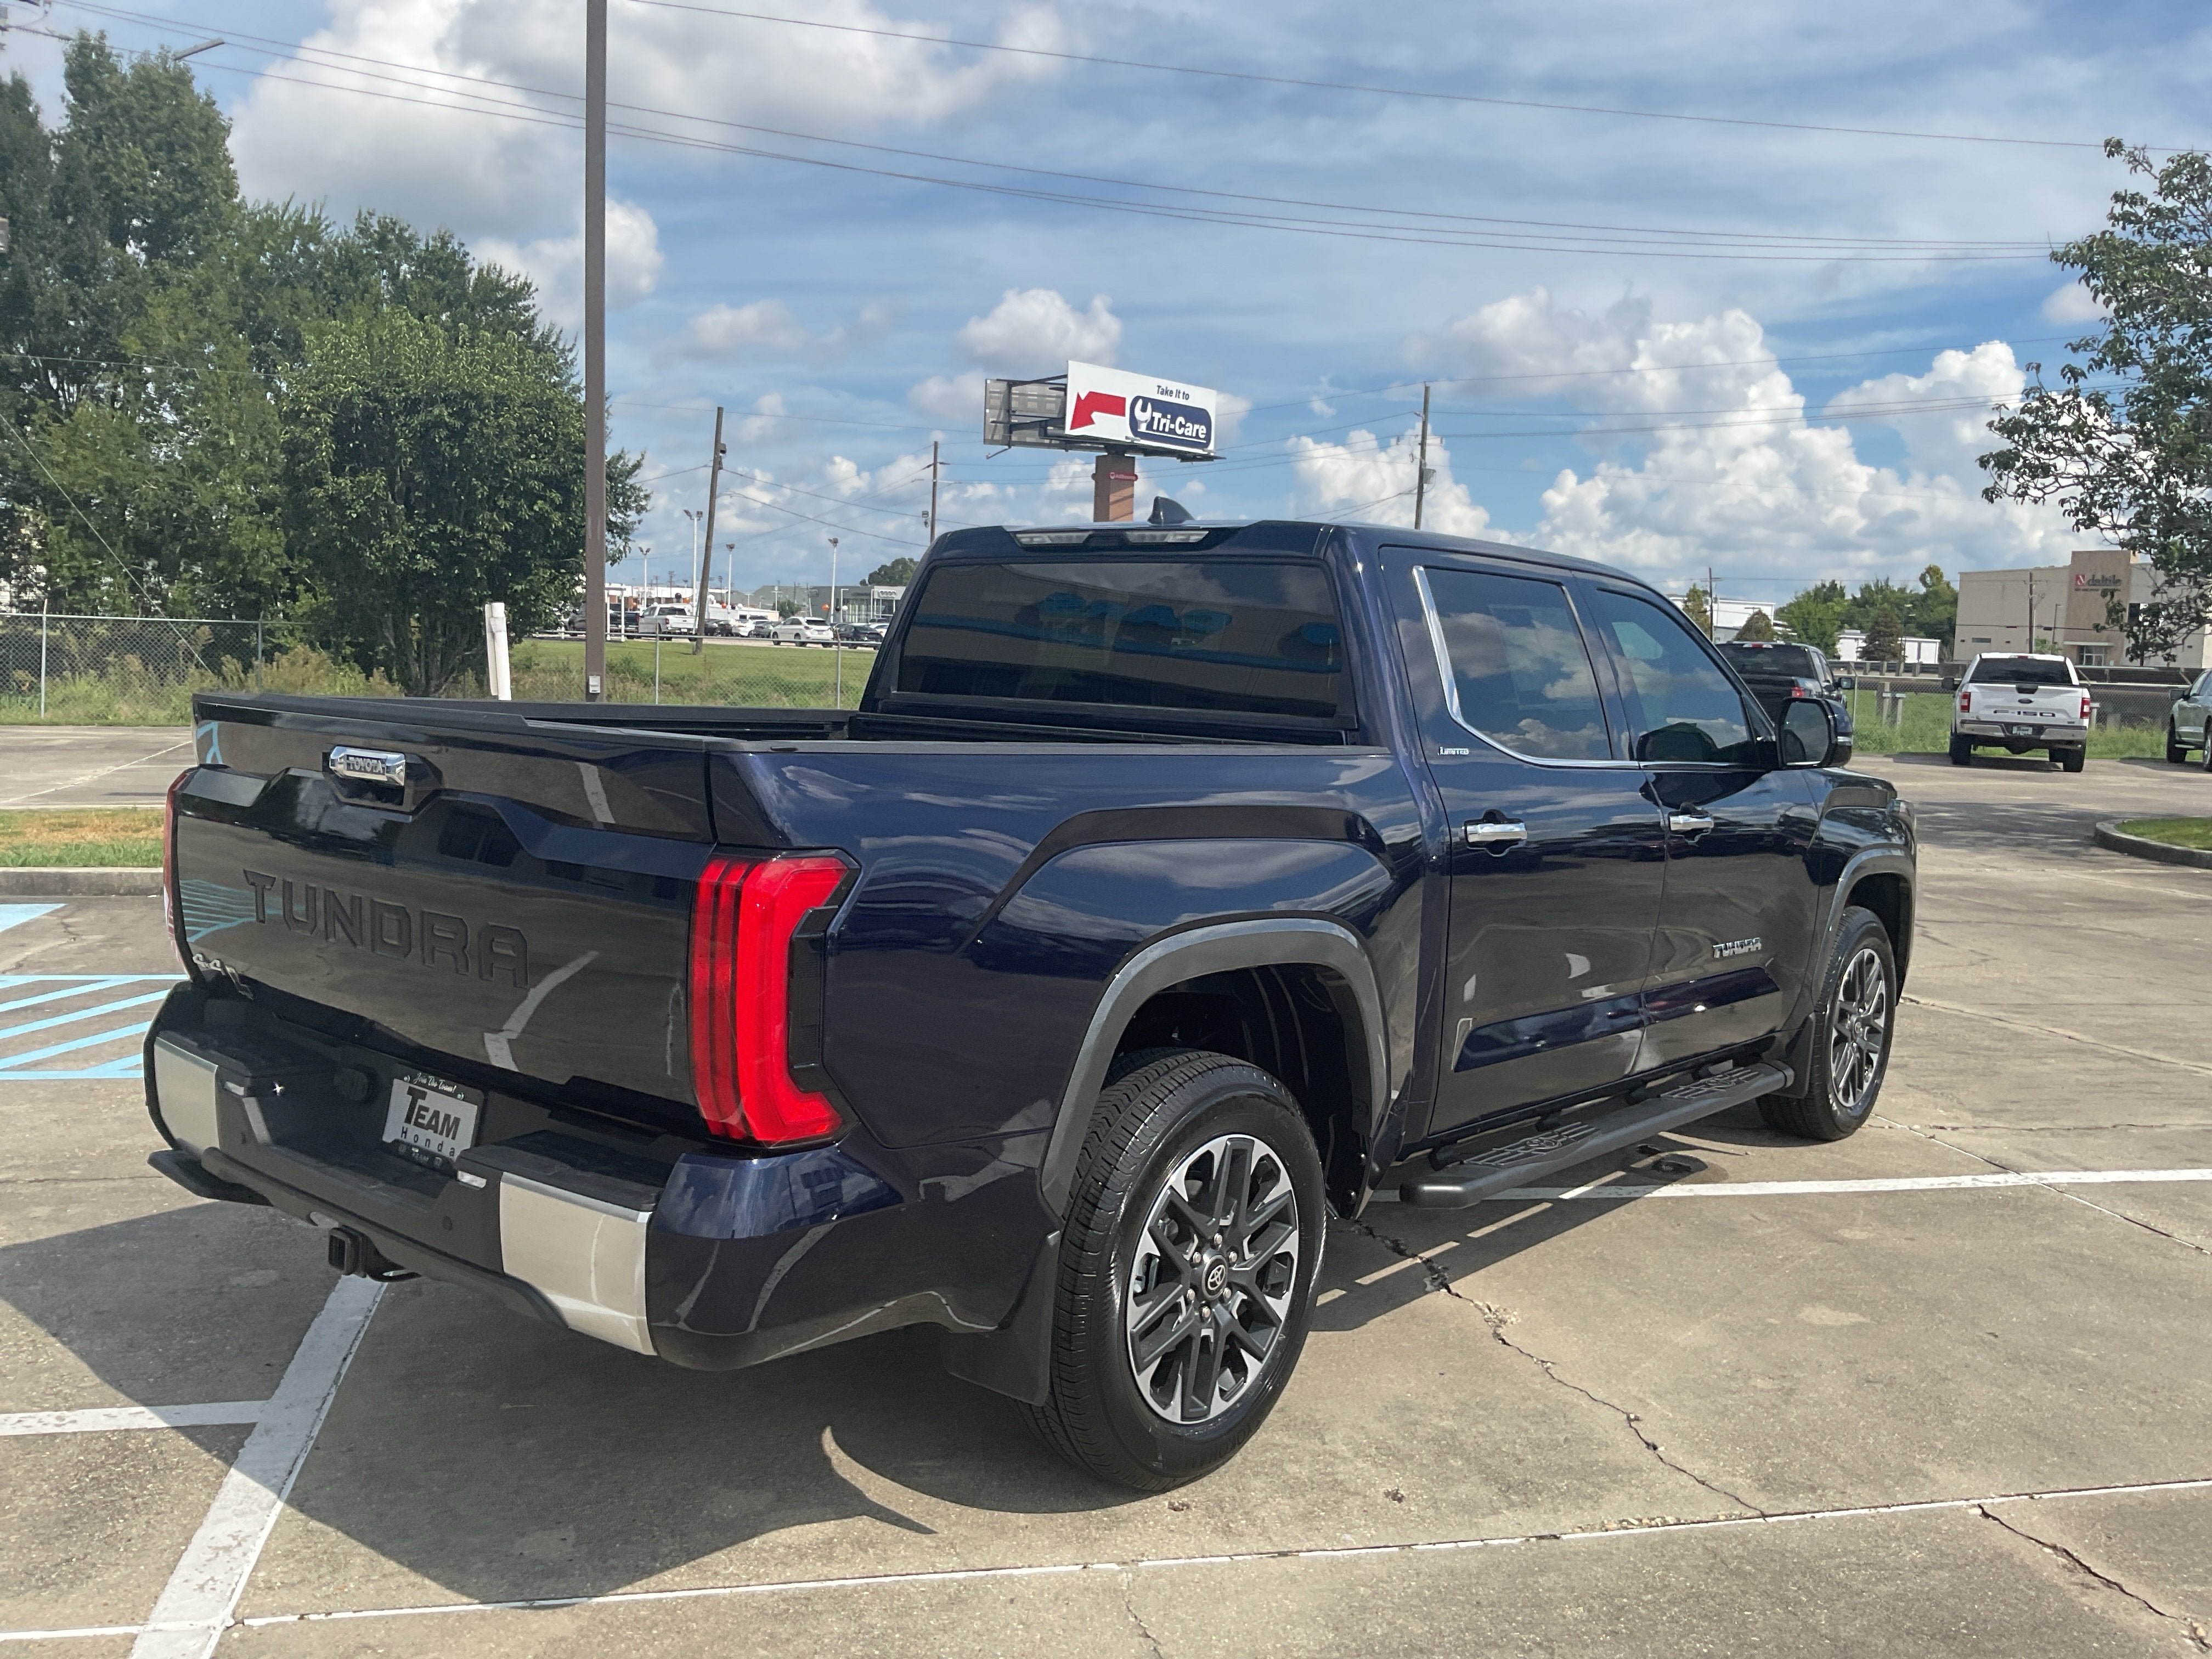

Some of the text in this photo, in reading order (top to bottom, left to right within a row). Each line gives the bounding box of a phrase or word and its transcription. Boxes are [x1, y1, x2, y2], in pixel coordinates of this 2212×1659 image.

[1157, 385, 1189, 400] Take It to
[1153, 411, 1206, 438] Tri-Care
[348, 757, 382, 773] TOYOTA
[243, 869, 528, 988] TUNDRA
[1712, 938, 1762, 958] TUNDRA
[404, 1086, 461, 1141] TEAM
[400, 1126, 455, 1157] Honda
